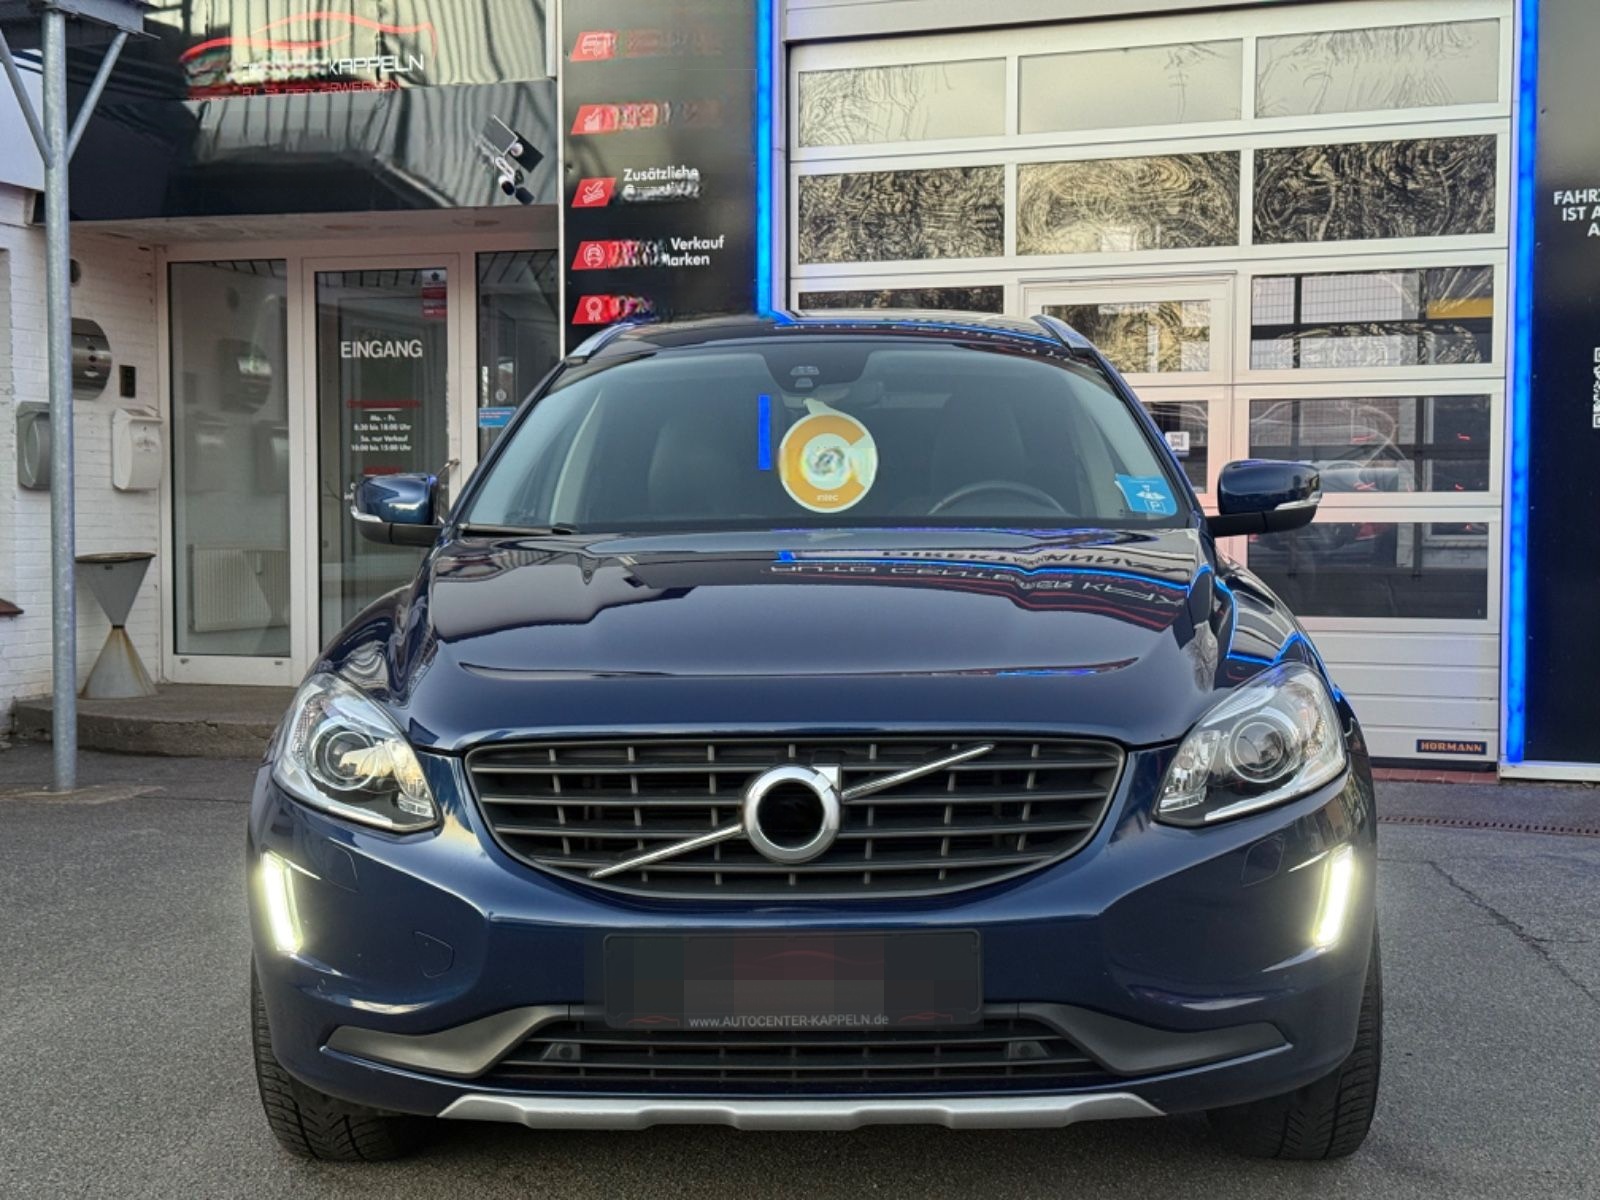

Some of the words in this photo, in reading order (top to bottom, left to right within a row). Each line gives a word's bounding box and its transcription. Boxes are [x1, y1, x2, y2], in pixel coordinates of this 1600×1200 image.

[623, 165, 700, 182] Zusätzliche
[1562, 206, 1587, 221] IST
[670, 235, 725, 251] Verkauf
[341, 339, 423, 358] EINGANG
[688, 1014, 889, 1028] www.AUTOCENTER-KAPPELN.de
